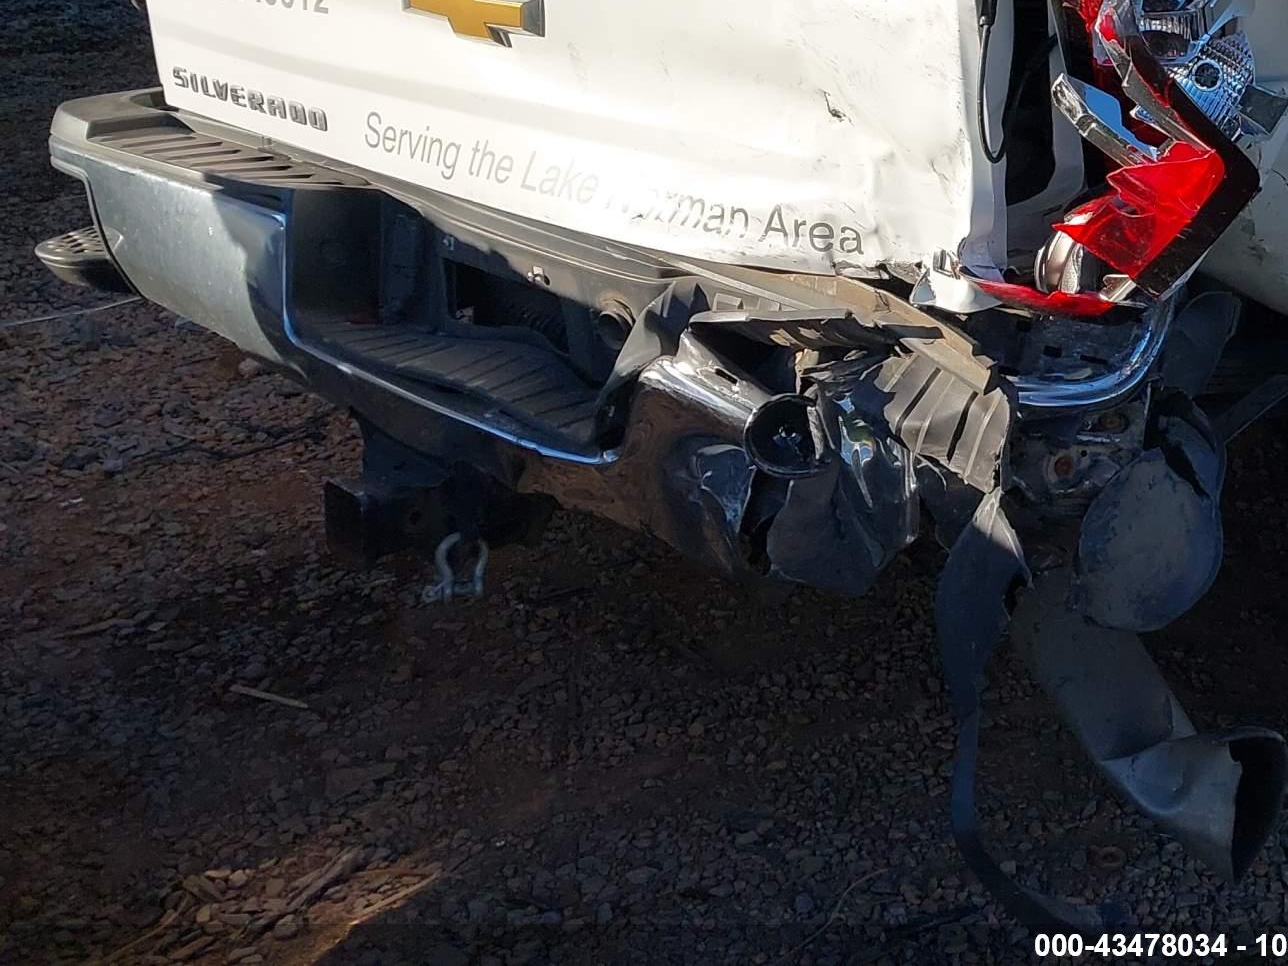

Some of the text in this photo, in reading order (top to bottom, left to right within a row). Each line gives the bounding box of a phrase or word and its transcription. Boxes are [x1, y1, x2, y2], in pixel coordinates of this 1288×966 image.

[172, 66, 328, 133] SILVERADO
[364, 110, 462, 182] Serving
[468, 137, 514, 186] the
[519, 149, 600, 207] Lake
[757, 203, 865, 256] Area
